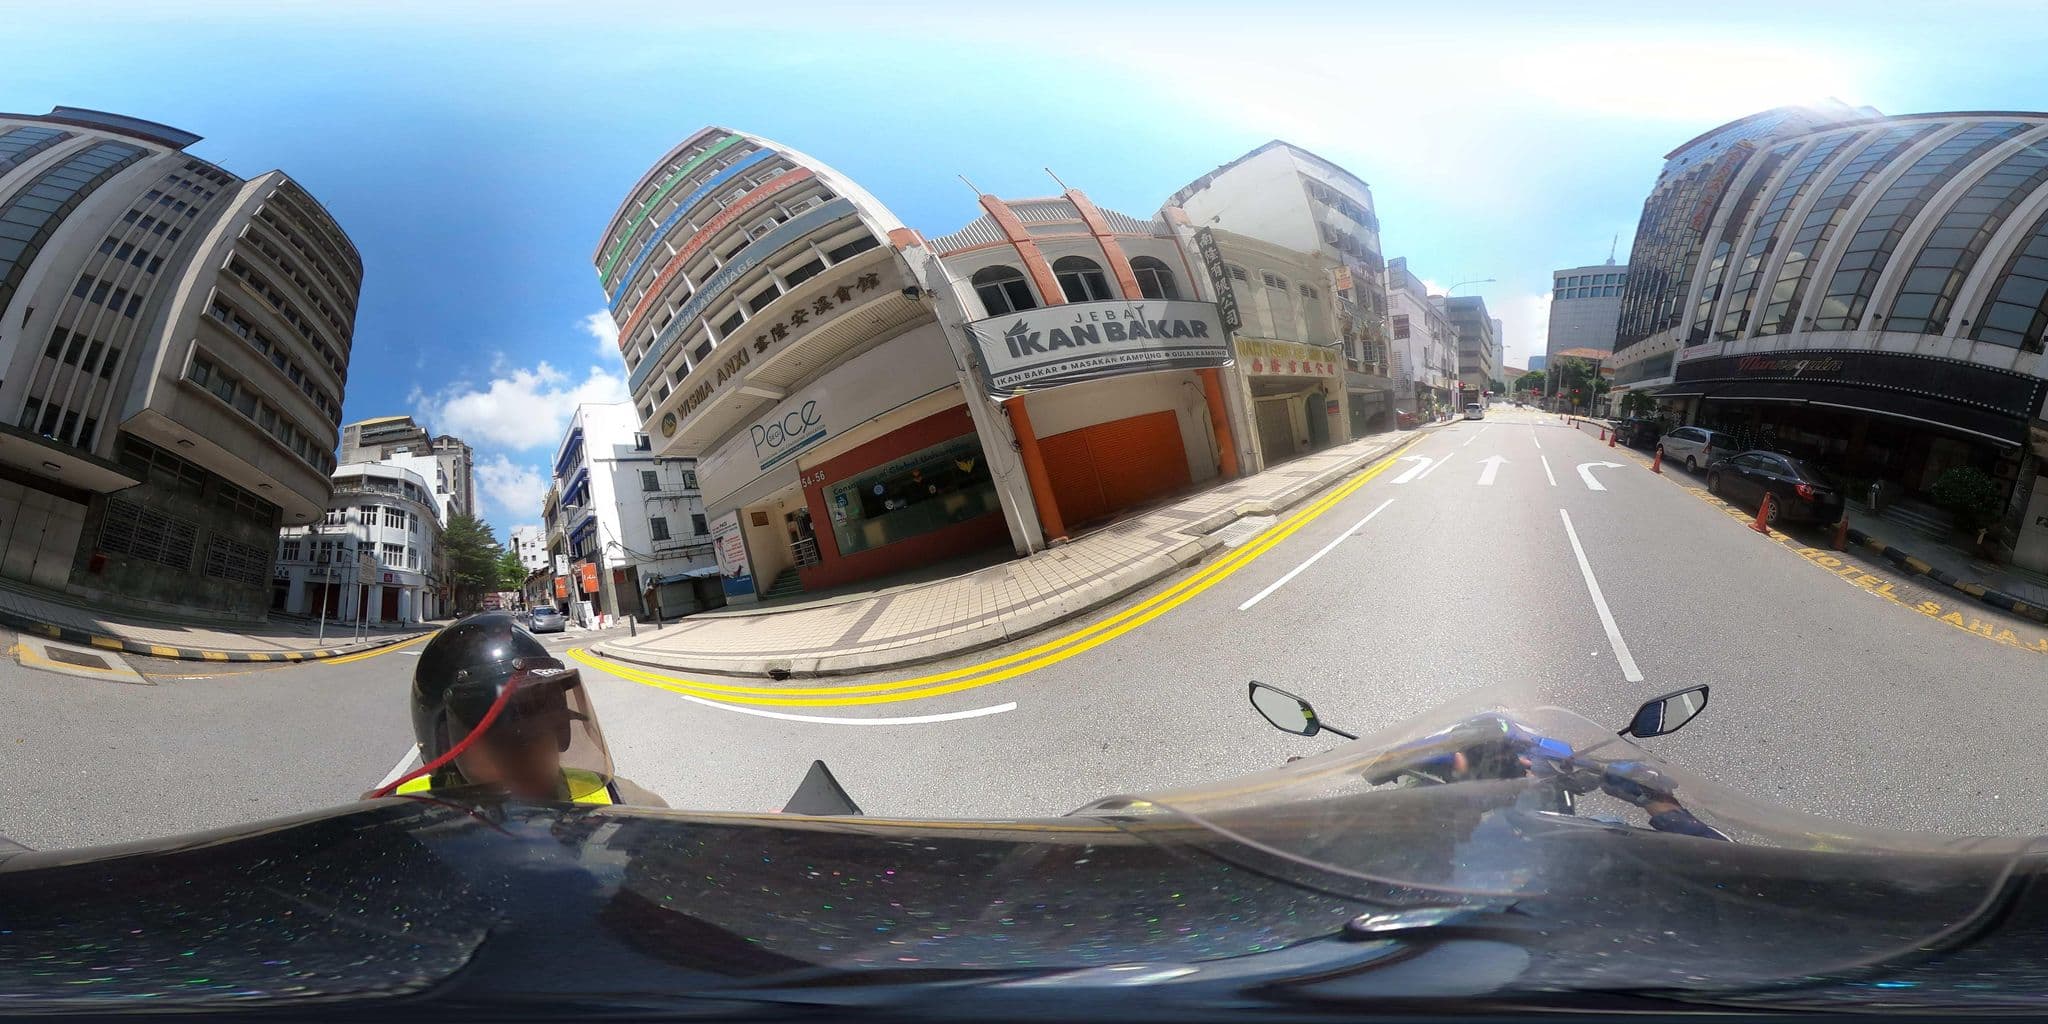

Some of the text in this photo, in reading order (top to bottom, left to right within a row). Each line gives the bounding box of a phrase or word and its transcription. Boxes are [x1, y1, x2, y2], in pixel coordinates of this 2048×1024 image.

[692, 256, 756, 315] LANGUAGE
[1075, 303, 1146, 329] JEBAT
[1003, 319, 1210, 359] IKAN BAKAR
[677, 347, 750, 420] WISMA ANXI
[996, 373, 1023, 386] IKAN
[1024, 367, 1058, 379] BAKAR
[1070, 357, 1119, 369] MASAKAN
[1119, 352, 1162, 362] KAMPUNG
[1194, 350, 1227, 358] KAMBING
[802, 470, 826, 488] 54-56
[1799, 547, 1898, 600] HOTEL
